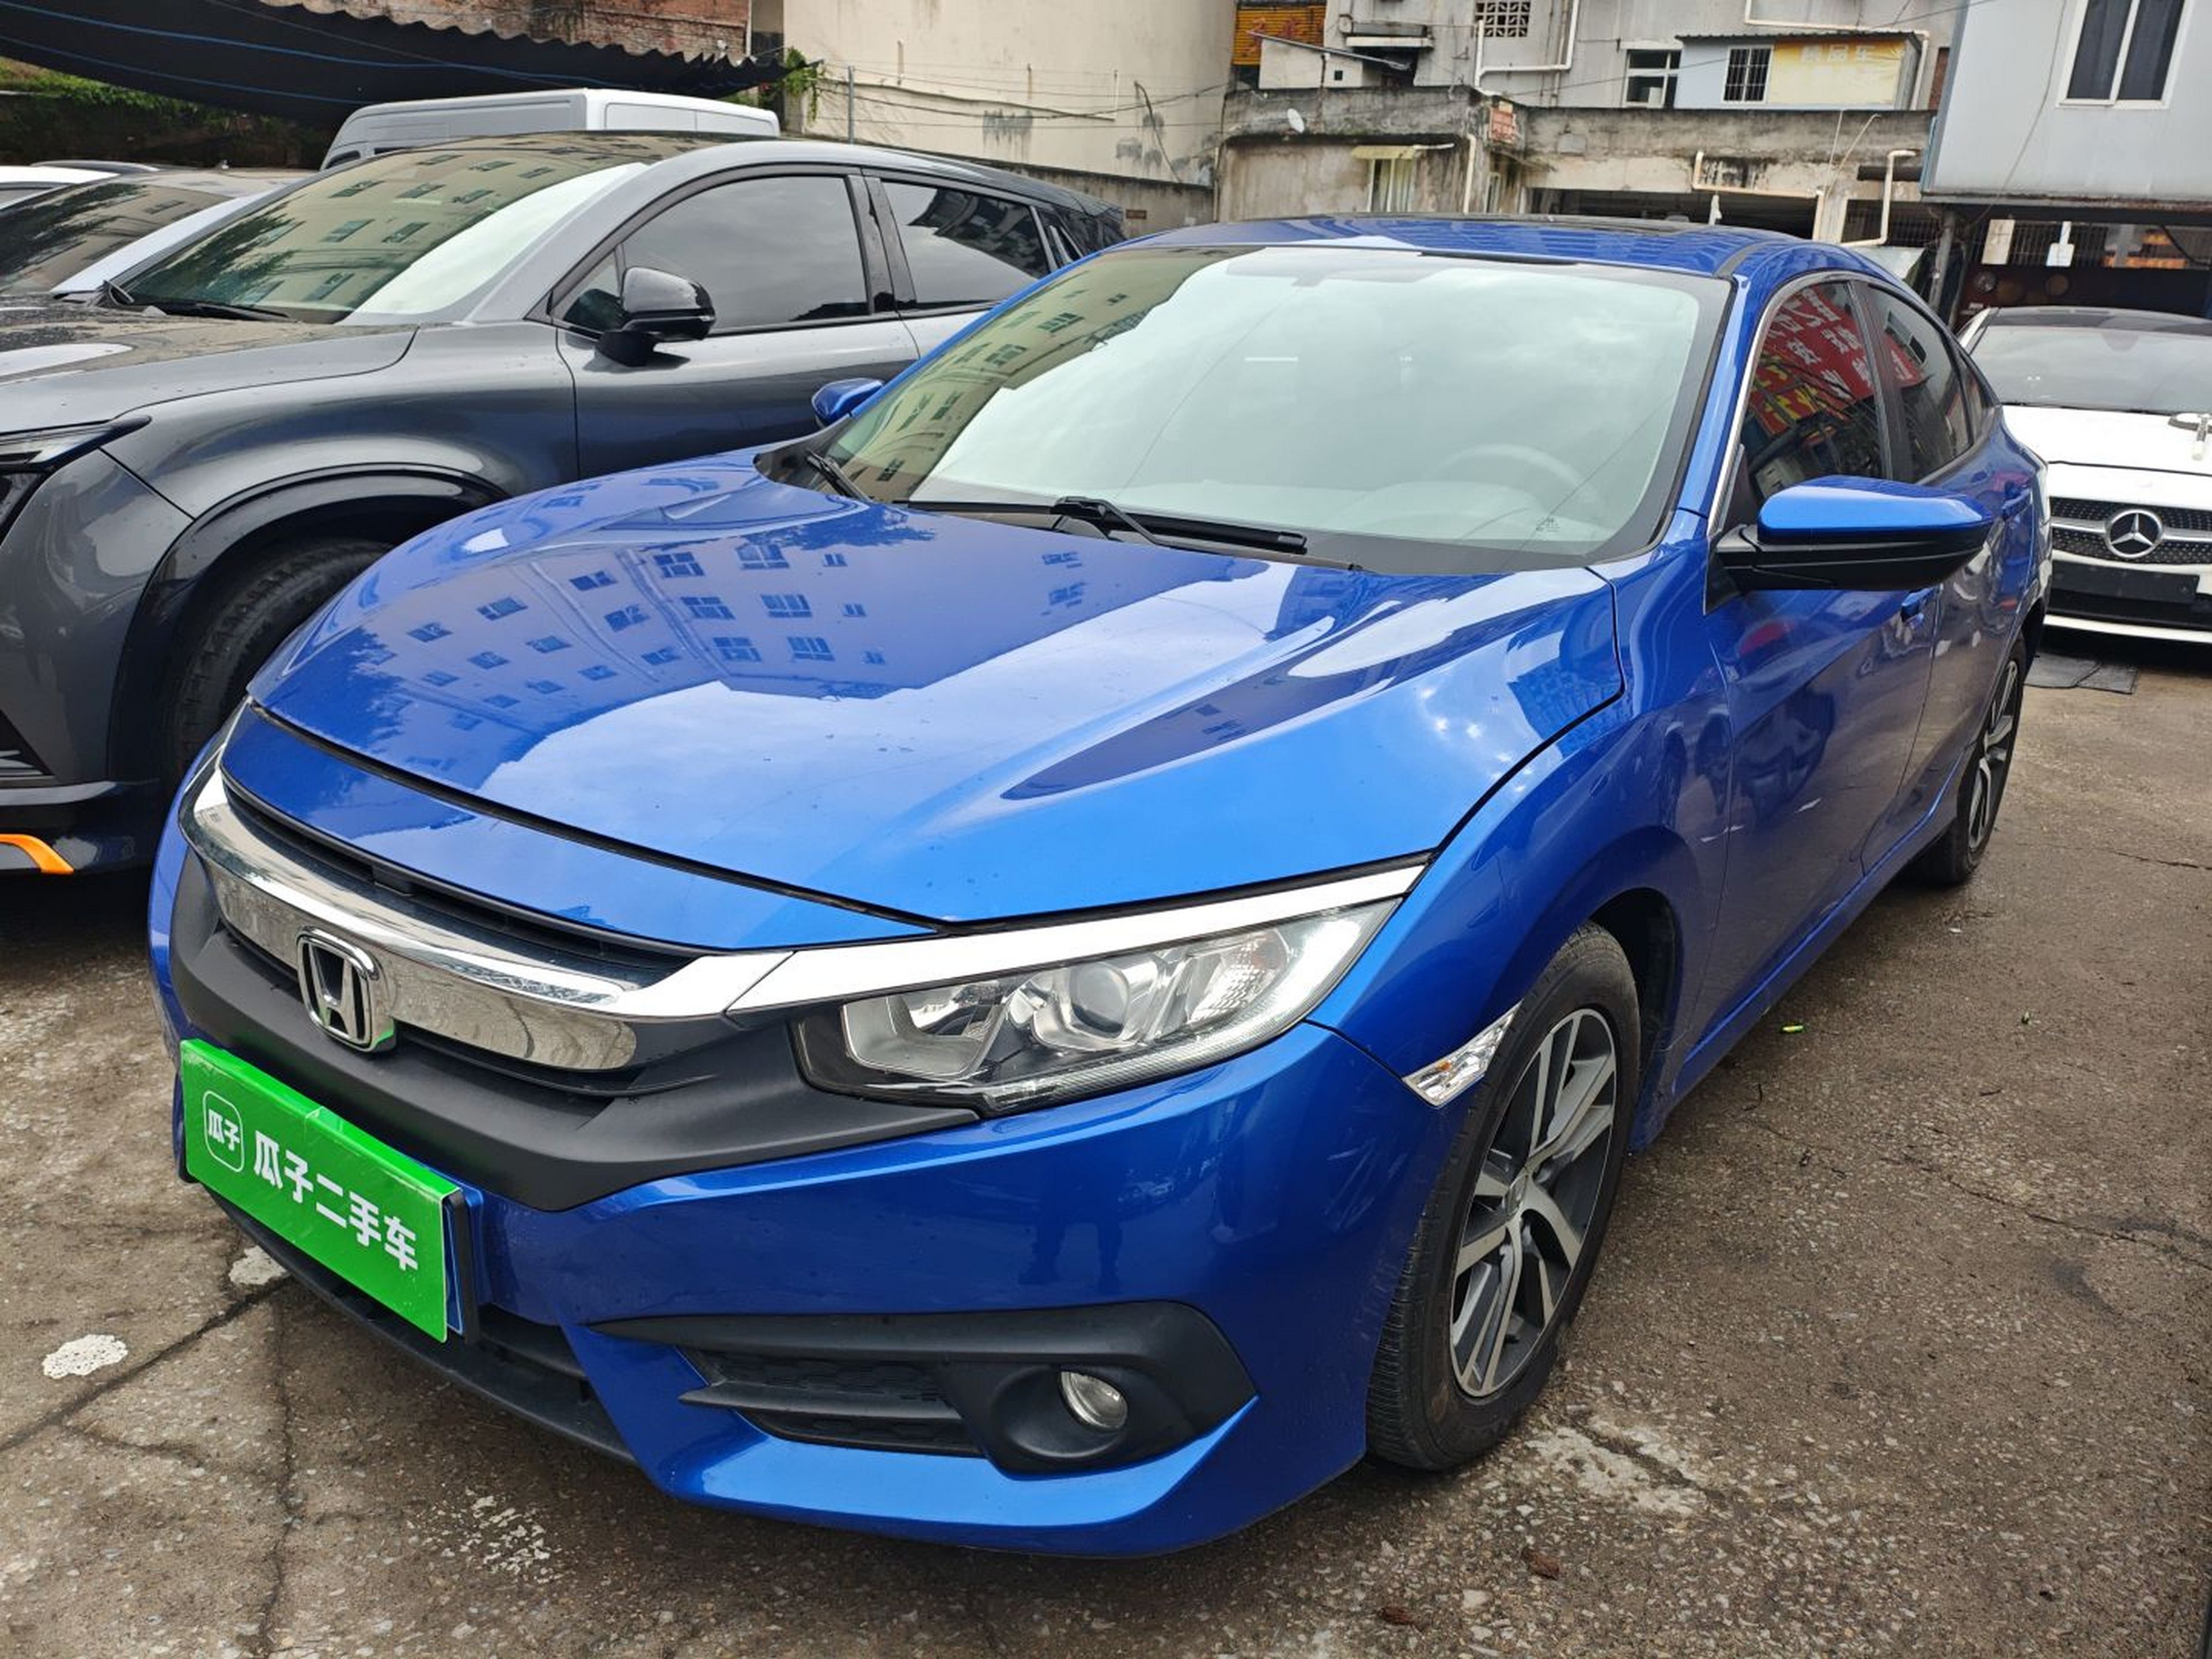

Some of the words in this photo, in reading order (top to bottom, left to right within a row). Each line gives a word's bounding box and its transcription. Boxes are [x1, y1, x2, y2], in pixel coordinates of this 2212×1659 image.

[208, 1108, 240, 1151] 瓜子
[253, 1130, 418, 1271] 瓜子二手车
